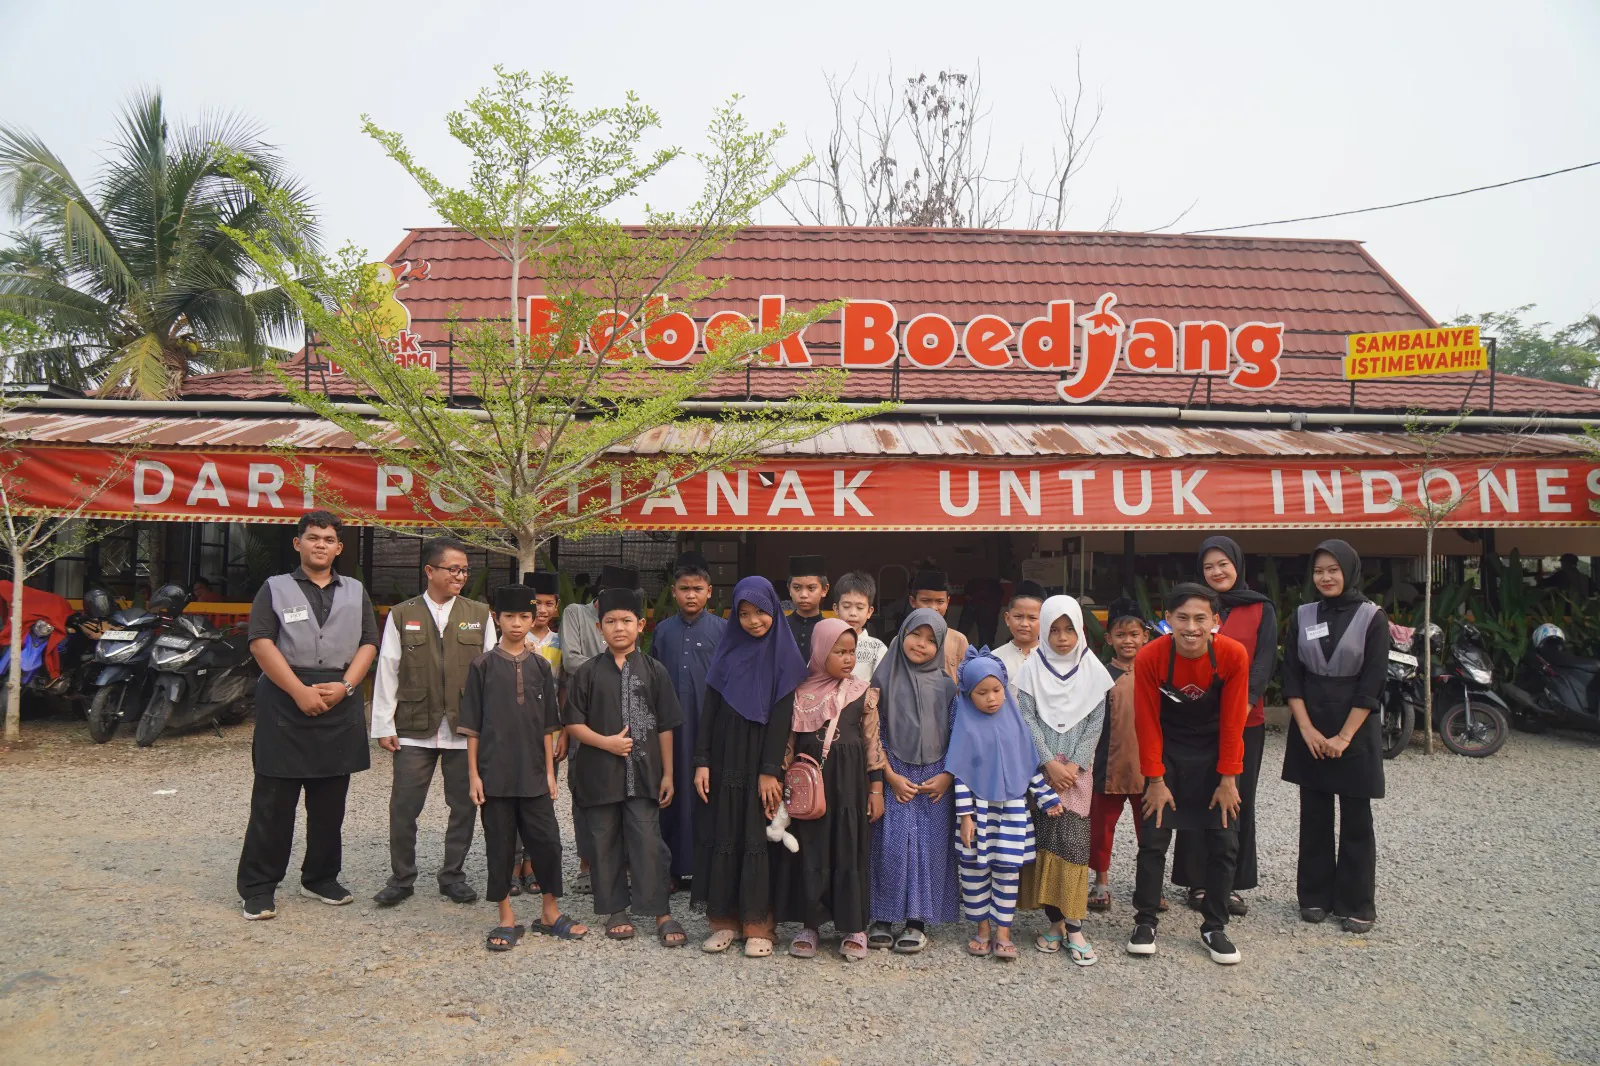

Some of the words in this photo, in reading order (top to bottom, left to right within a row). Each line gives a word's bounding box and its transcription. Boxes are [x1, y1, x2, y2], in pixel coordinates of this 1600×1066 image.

[841, 292, 1285, 403] Boedjang
[1355, 329, 1475, 354] SAMBALNYE
[1350, 350, 1482, 375] ISTIMEWAH!!!
[133, 460, 316, 509] DARI
[375, 464, 875, 517] POTIANAK
[939, 469, 1213, 518] UNTUK
